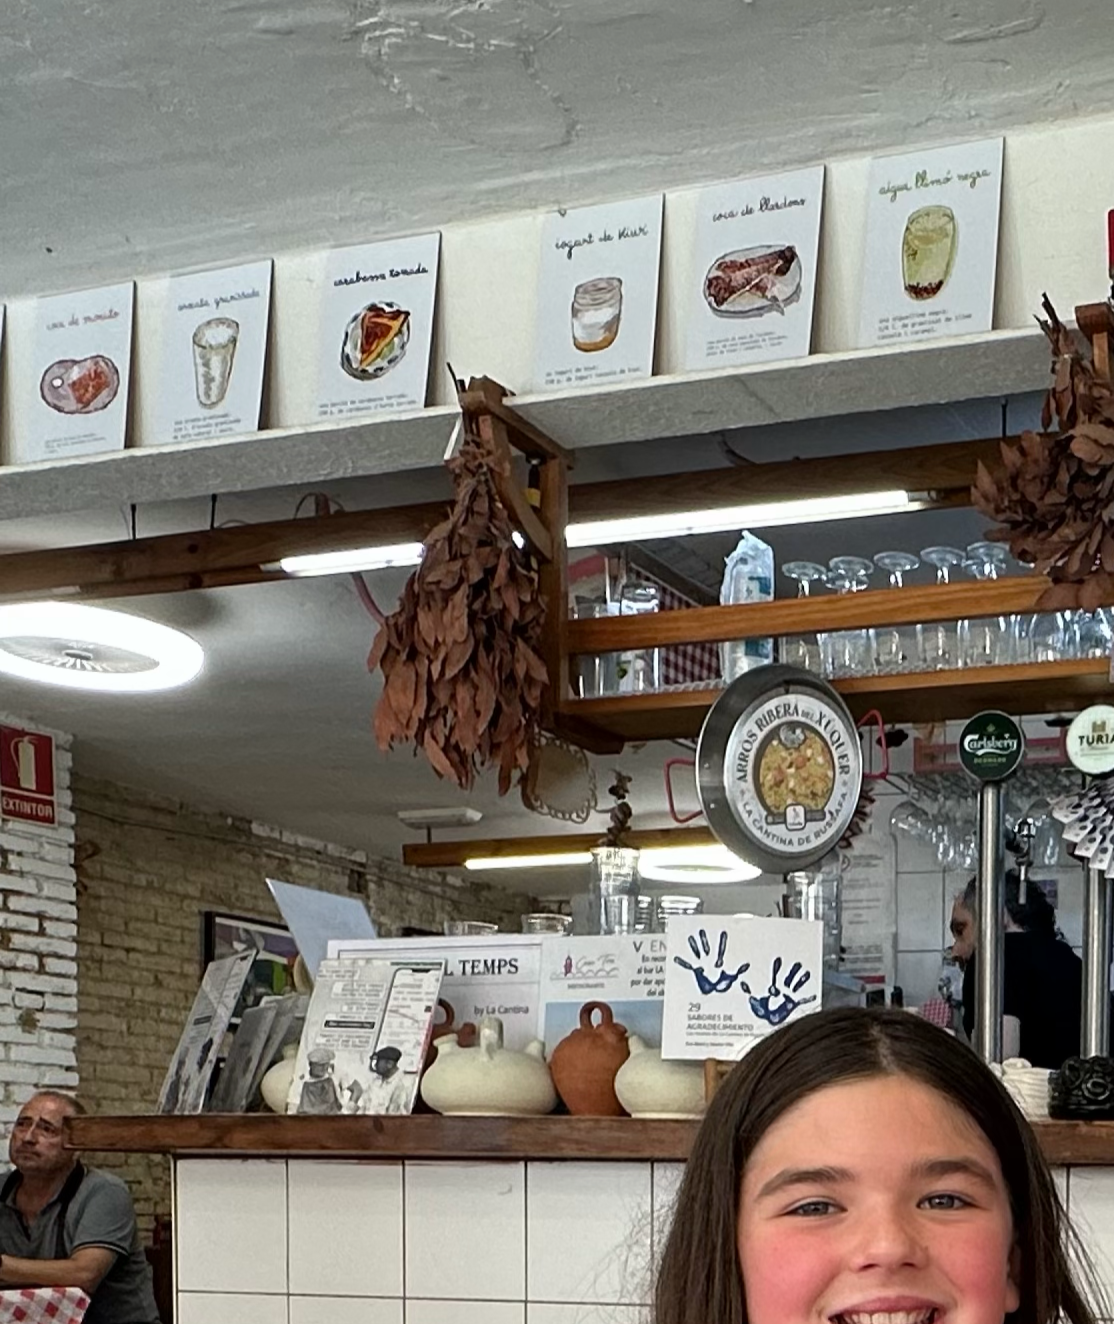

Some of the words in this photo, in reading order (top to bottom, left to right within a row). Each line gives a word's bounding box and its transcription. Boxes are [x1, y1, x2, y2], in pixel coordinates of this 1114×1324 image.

[878, 181, 912, 202] aigua
[957, 169, 991, 189] negra
[712, 209, 739, 222] coca
[741, 203, 755, 216] de
[599, 228, 614, 242] de
[68, 313, 80, 327] de
[963, 732, 1018, 756] Carlsberg
[2, 796, 53, 819] EXTINTOR
[743, 802, 753, 818] LA
[752, 818, 794, 846] CANTINA
[797, 837, 812, 846] DE
[632, 940, 644, 953] V
[458, 958, 519, 976] TEMPS
[474, 1005, 484, 1016] by
[486, 1005, 496, 1015] La
[497, 1005, 529, 1015] Cantina
[688, 1002, 701, 1013] 29
[687, 1013, 721, 1022] SABORES
[723, 1013, 734, 1022] DE
[686, 1023, 754, 1032] AGRADECIMIENTO
